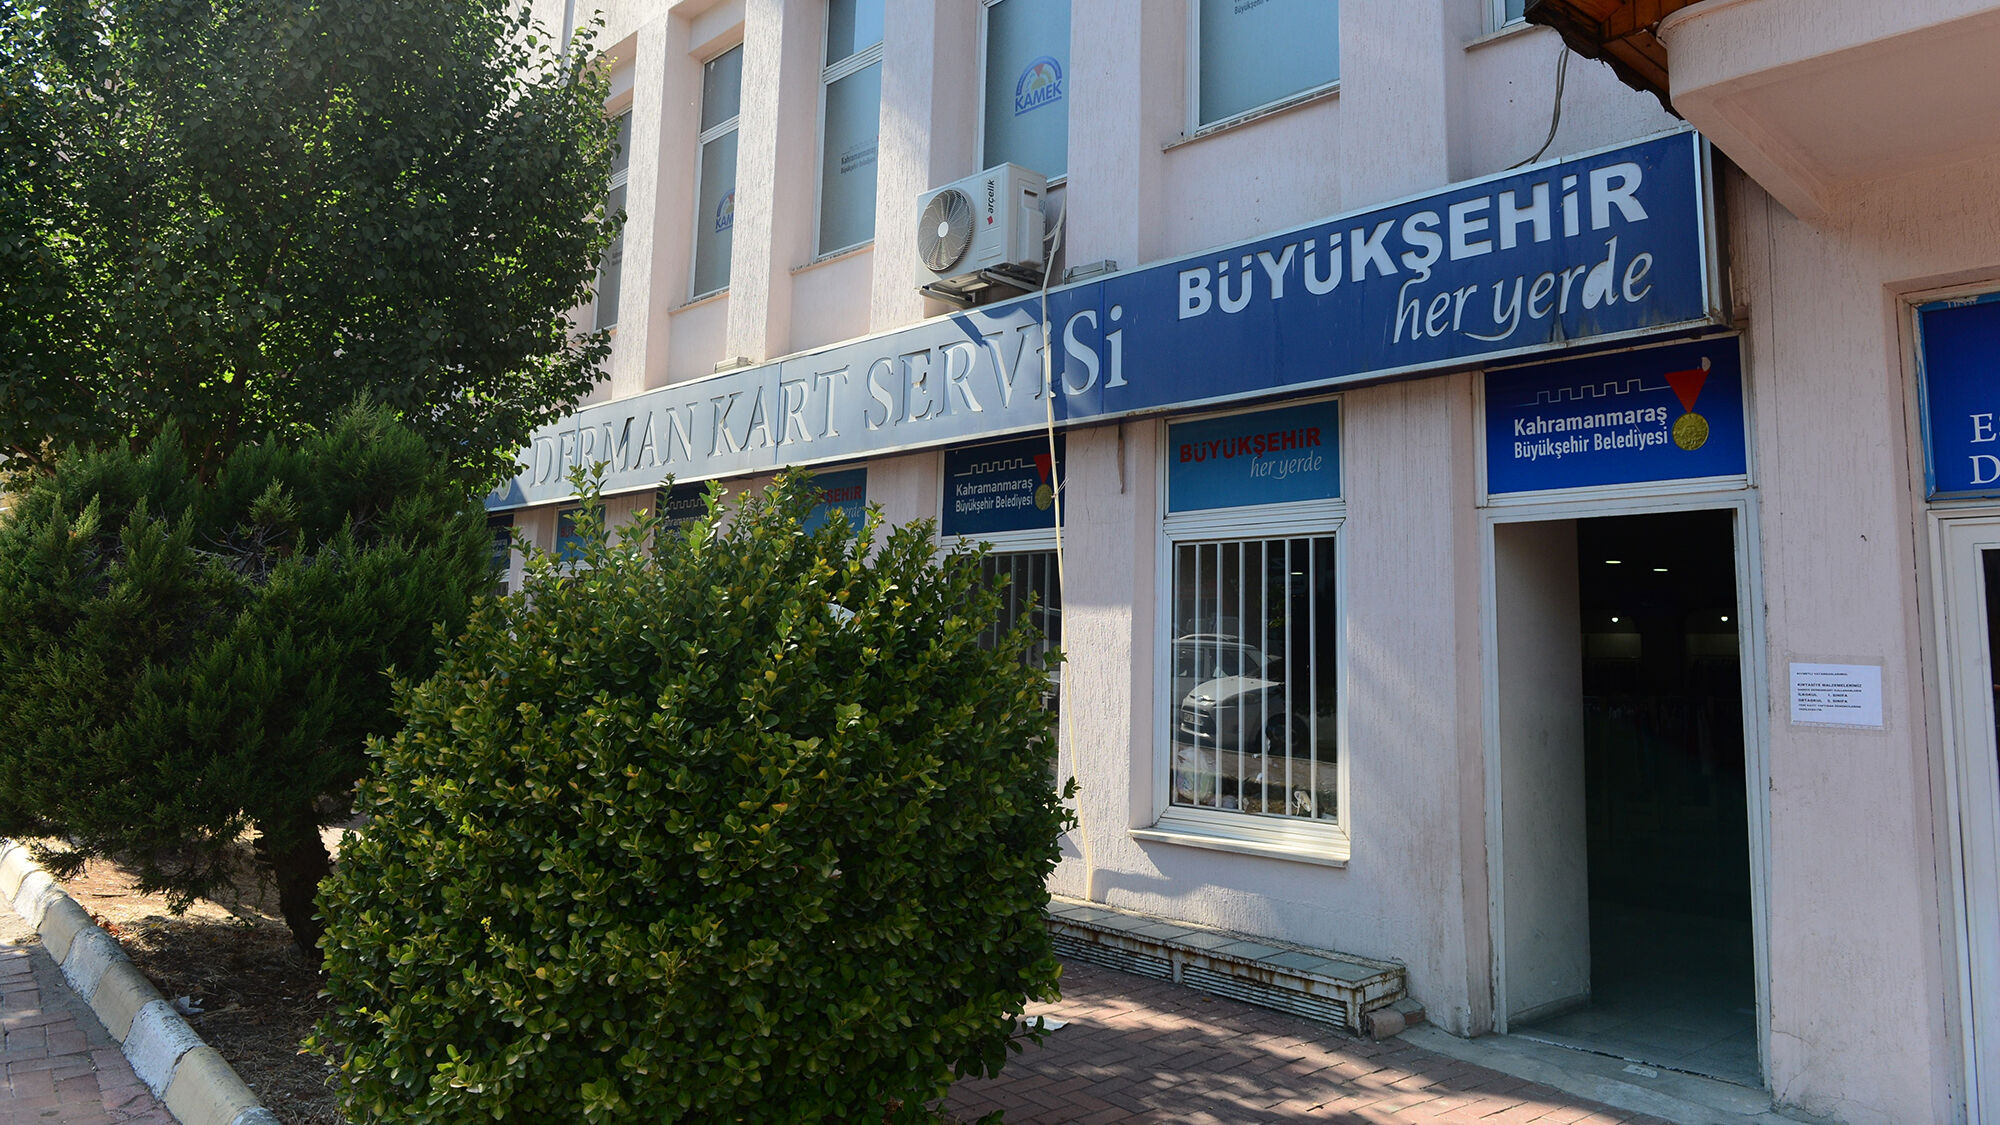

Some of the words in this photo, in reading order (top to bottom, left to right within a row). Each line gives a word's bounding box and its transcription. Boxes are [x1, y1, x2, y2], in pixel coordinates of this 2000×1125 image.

[1015, 80, 1062, 112] KAMEK
[987, 179, 996, 214] arçelik
[1393, 275, 1478, 344] her
[1463, 235, 1653, 342] yerde
[530, 401, 698, 488] DERMAN
[707, 364, 850, 458] KART
[1513, 405, 1668, 437] Kahramanmaraş
[1969, 412, 2000, 443] E
[1513, 434, 1589, 462] Büyükşehir
[1594, 426, 1668, 451] Belediyesi
[1250, 456, 1276, 478] her
[1272, 450, 1322, 480] yerde
[956, 479, 1033, 496] Kahramanmaraş
[955, 499, 994, 515] Büyükşehir
[995, 493, 1033, 509] Belediyesi
